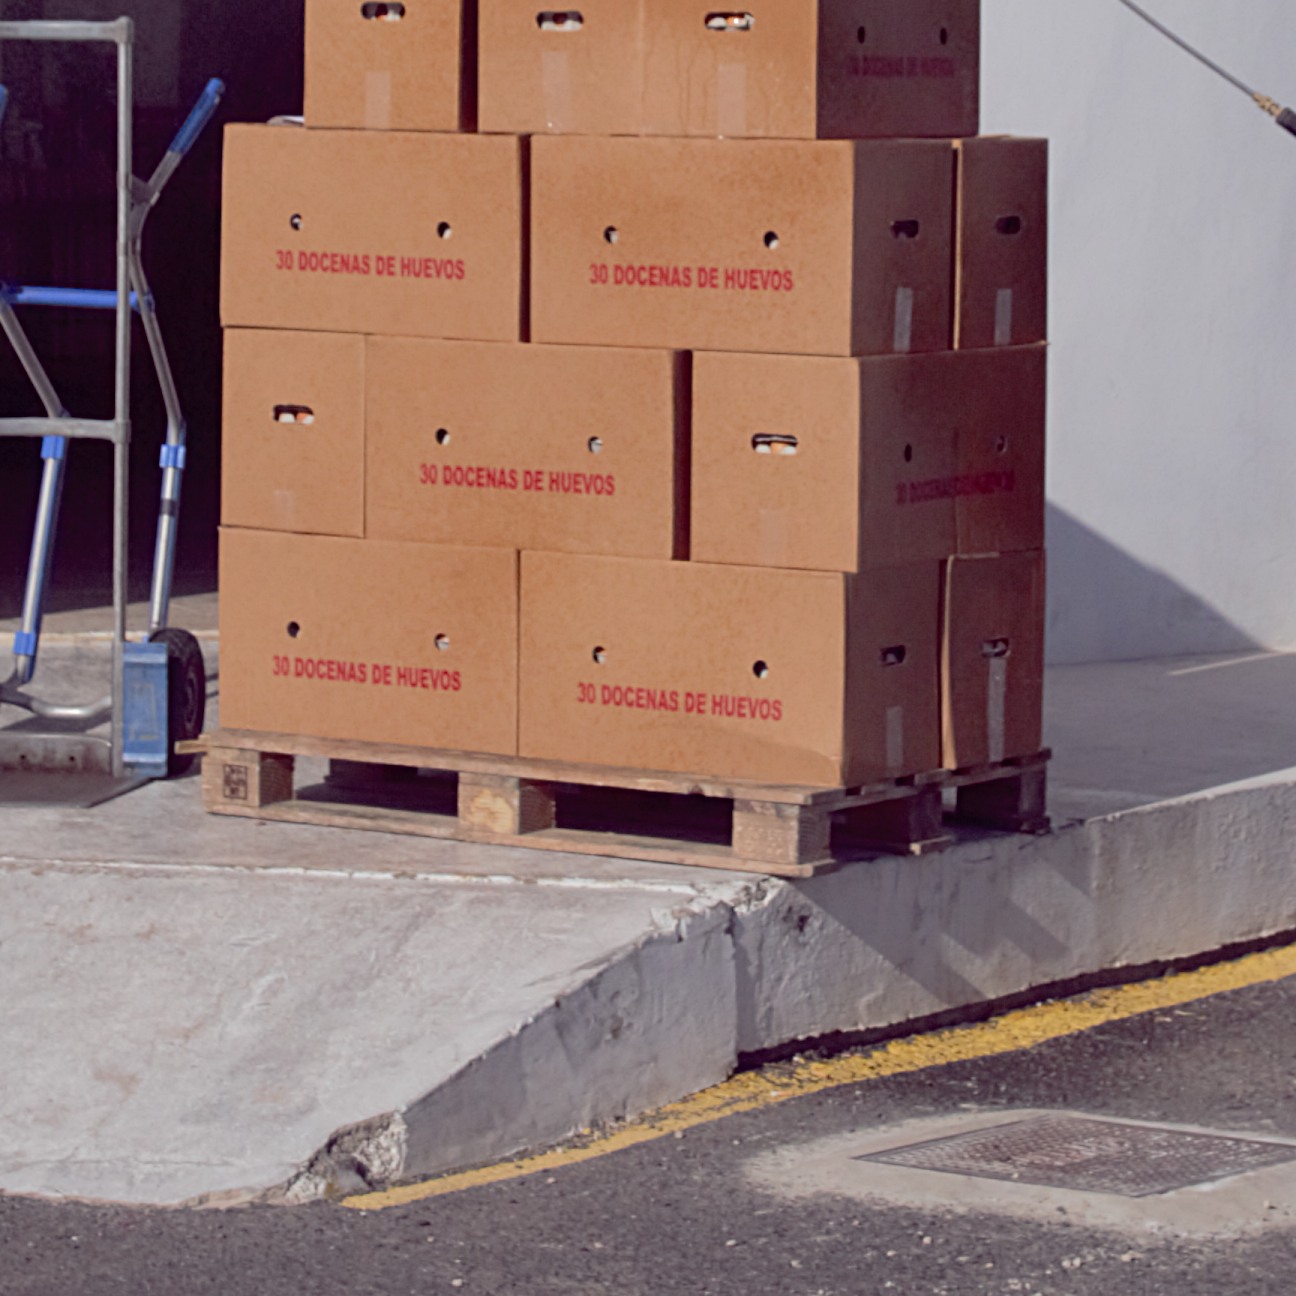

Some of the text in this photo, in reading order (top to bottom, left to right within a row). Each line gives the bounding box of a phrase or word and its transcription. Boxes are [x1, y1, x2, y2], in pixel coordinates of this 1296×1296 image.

[276, 249, 465, 280] 30 DOCENAS DE HUEVOS
[590, 264, 793, 291] 30 DOCENAS DE HUEVOS
[419, 463, 615, 496] 30 DOCENAS DE HUEVOS
[272, 655, 462, 691] 30 DOCENAS DE HUEVOS
[577, 682, 782, 721] 30 DOCENAS DE HUEVOS
